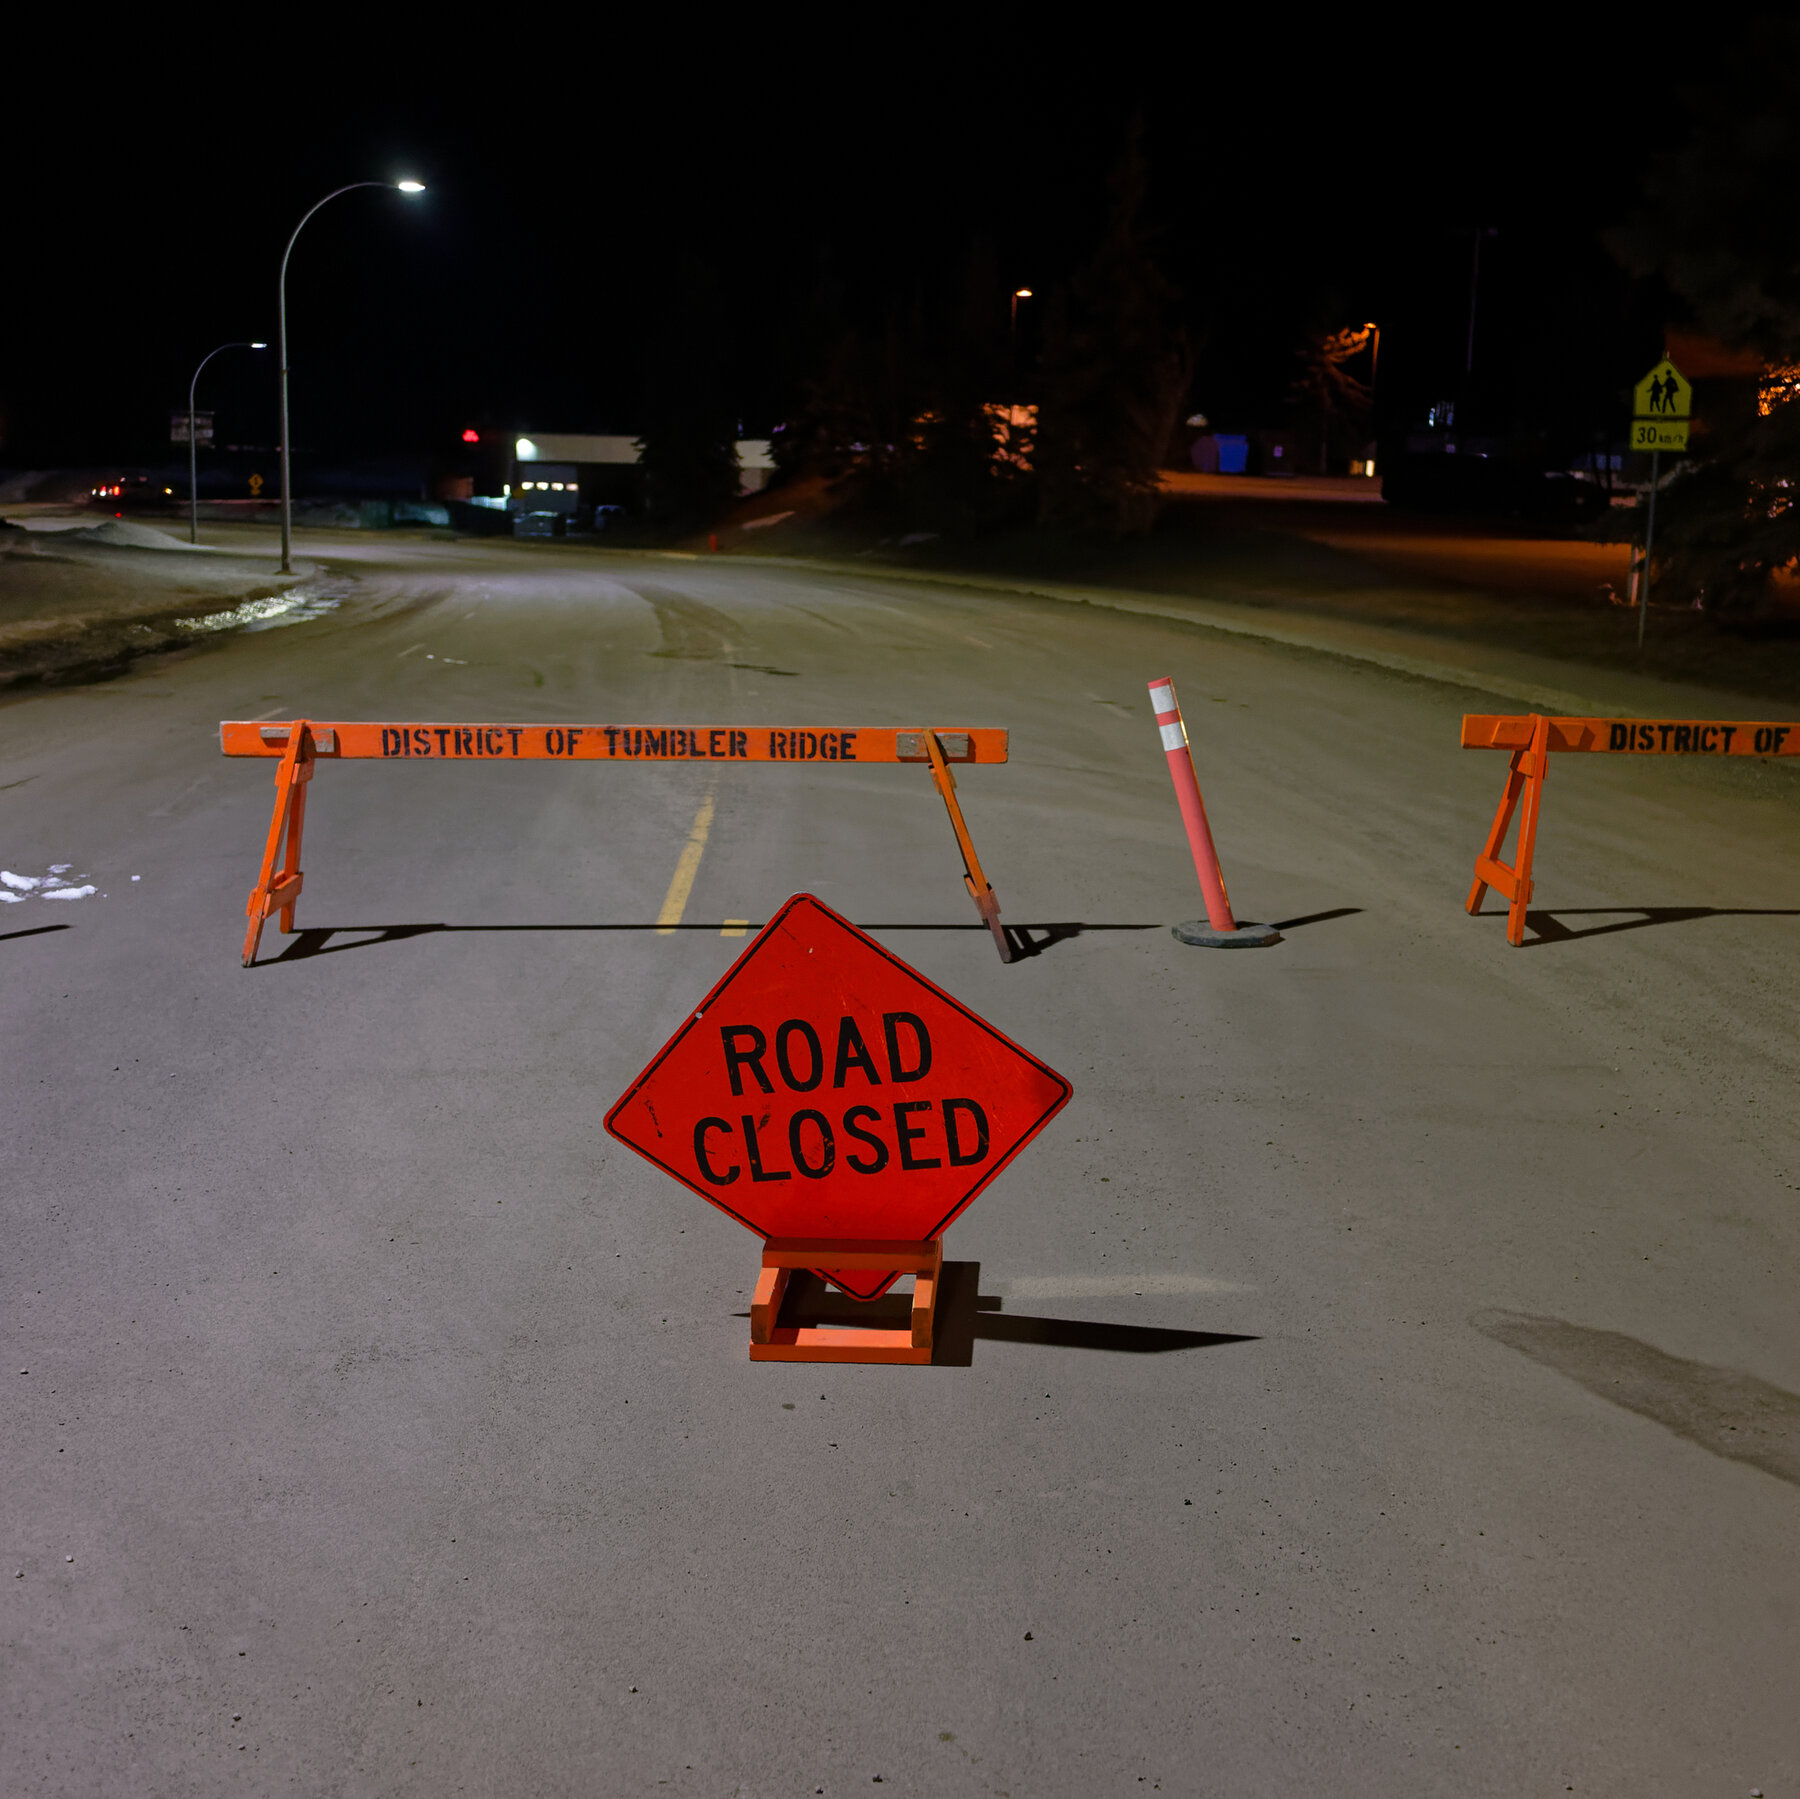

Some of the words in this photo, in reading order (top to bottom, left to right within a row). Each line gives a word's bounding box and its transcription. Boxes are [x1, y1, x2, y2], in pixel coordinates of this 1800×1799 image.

[1637, 427, 1657, 444] 30
[382, 728, 524, 757] DISTRICT
[545, 728, 583, 756] OF
[604, 728, 748, 758] TUMBLER
[769, 731, 857, 760] RIDGE
[1609, 723, 1737, 753] DISTRICT
[1754, 727, 1791, 753] OF
[720, 1011, 933, 1097] ROAD
[693, 1097, 990, 1187] CLOSED
